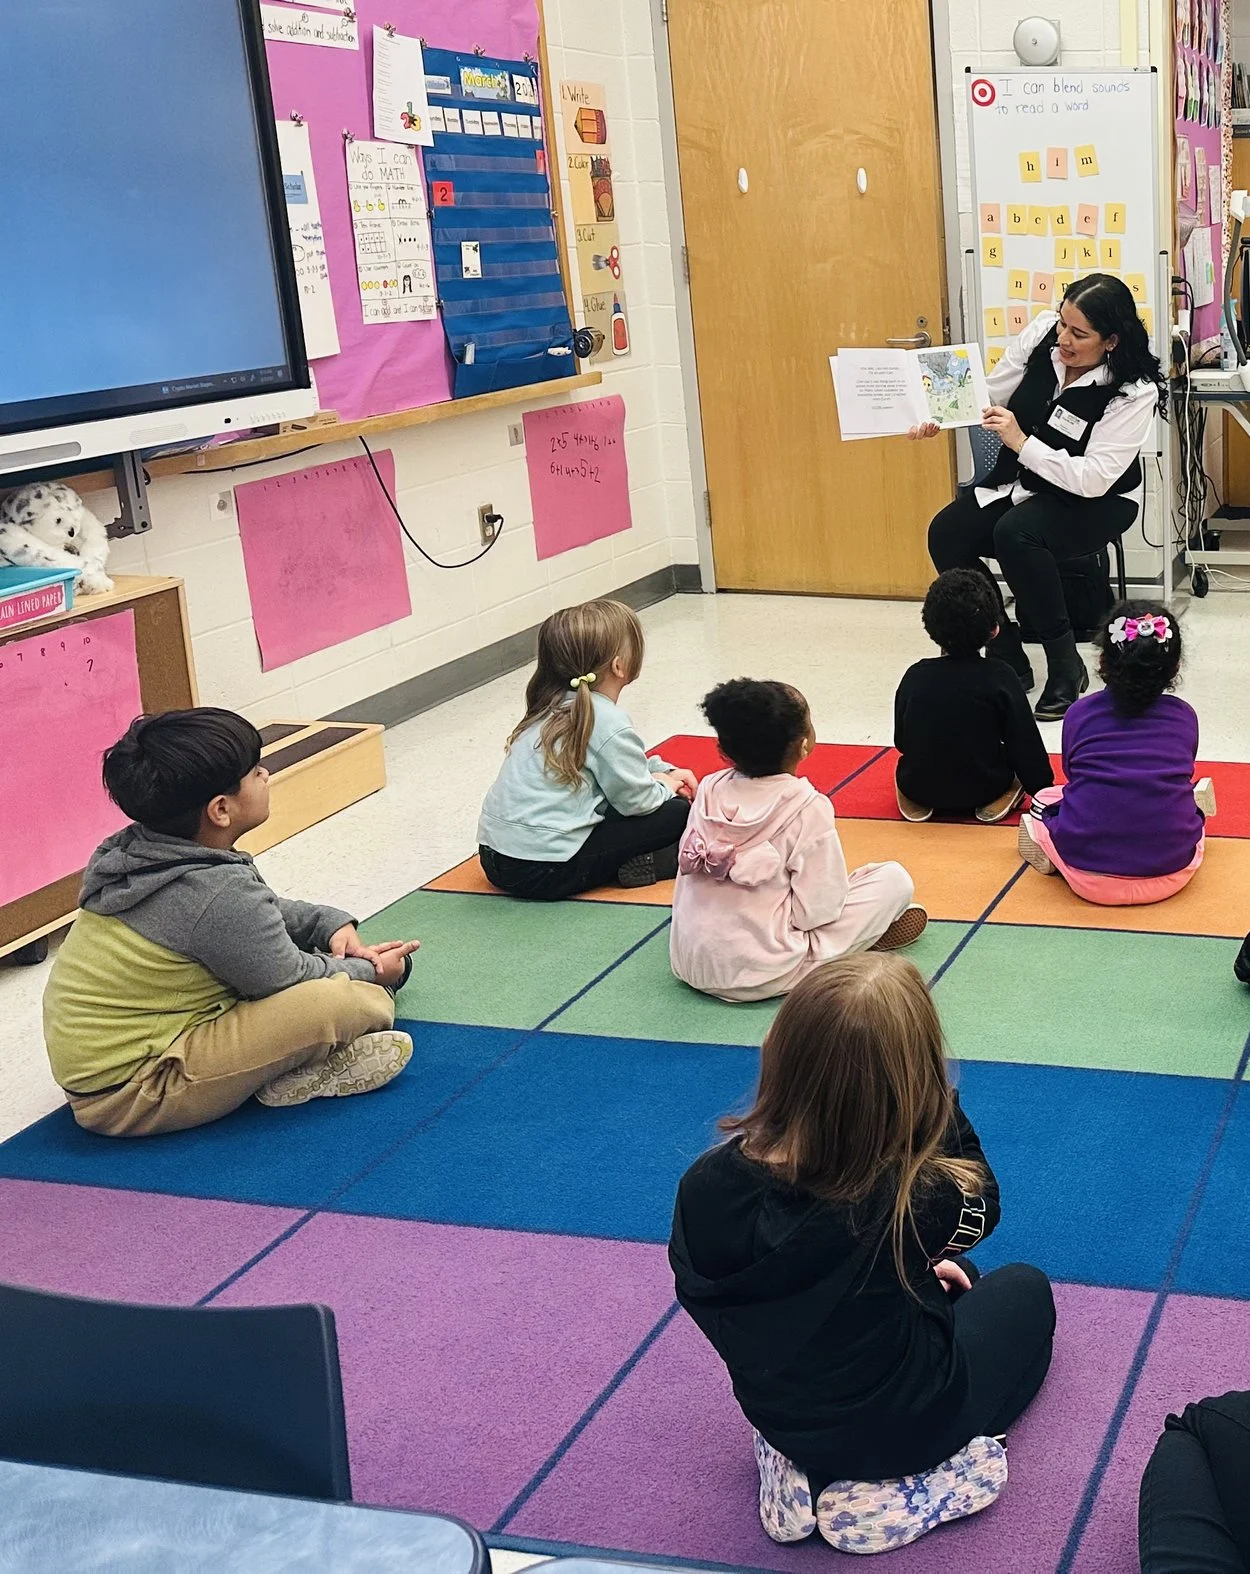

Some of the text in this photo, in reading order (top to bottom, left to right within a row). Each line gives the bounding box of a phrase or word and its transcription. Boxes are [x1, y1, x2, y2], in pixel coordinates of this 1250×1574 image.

[267, 19, 284, 34] solve
[313, 24, 324, 39] and
[463, 71, 502, 89] March
[999, 77, 1130, 97] I can blend sounds
[567, 86, 591, 105] Write
[995, 100, 1089, 115] to read a word
[351, 147, 413, 169] Ways I can
[1026, 161, 1035, 172] h
[1080, 155, 1093, 166] m
[362, 167, 405, 181] do MATH
[439, 188, 448, 202] 2
[987, 212, 1119, 225] a b c d e f
[989, 247, 997, 259] g
[1083, 246, 1092, 257] k
[1015, 280, 1022, 289] n
[1039, 283, 1046, 291] o
[1133, 284, 1139, 292] s
[1014, 316, 1022, 324] u
[550, 461, 563, 476] 6+1
[580, 458, 601, 483] 5+2
[0, 591, 62, 621] AIN LINED PAPER
[17, 637, 92, 662] 7 8 9 10
[86, 659, 94, 672] 7
